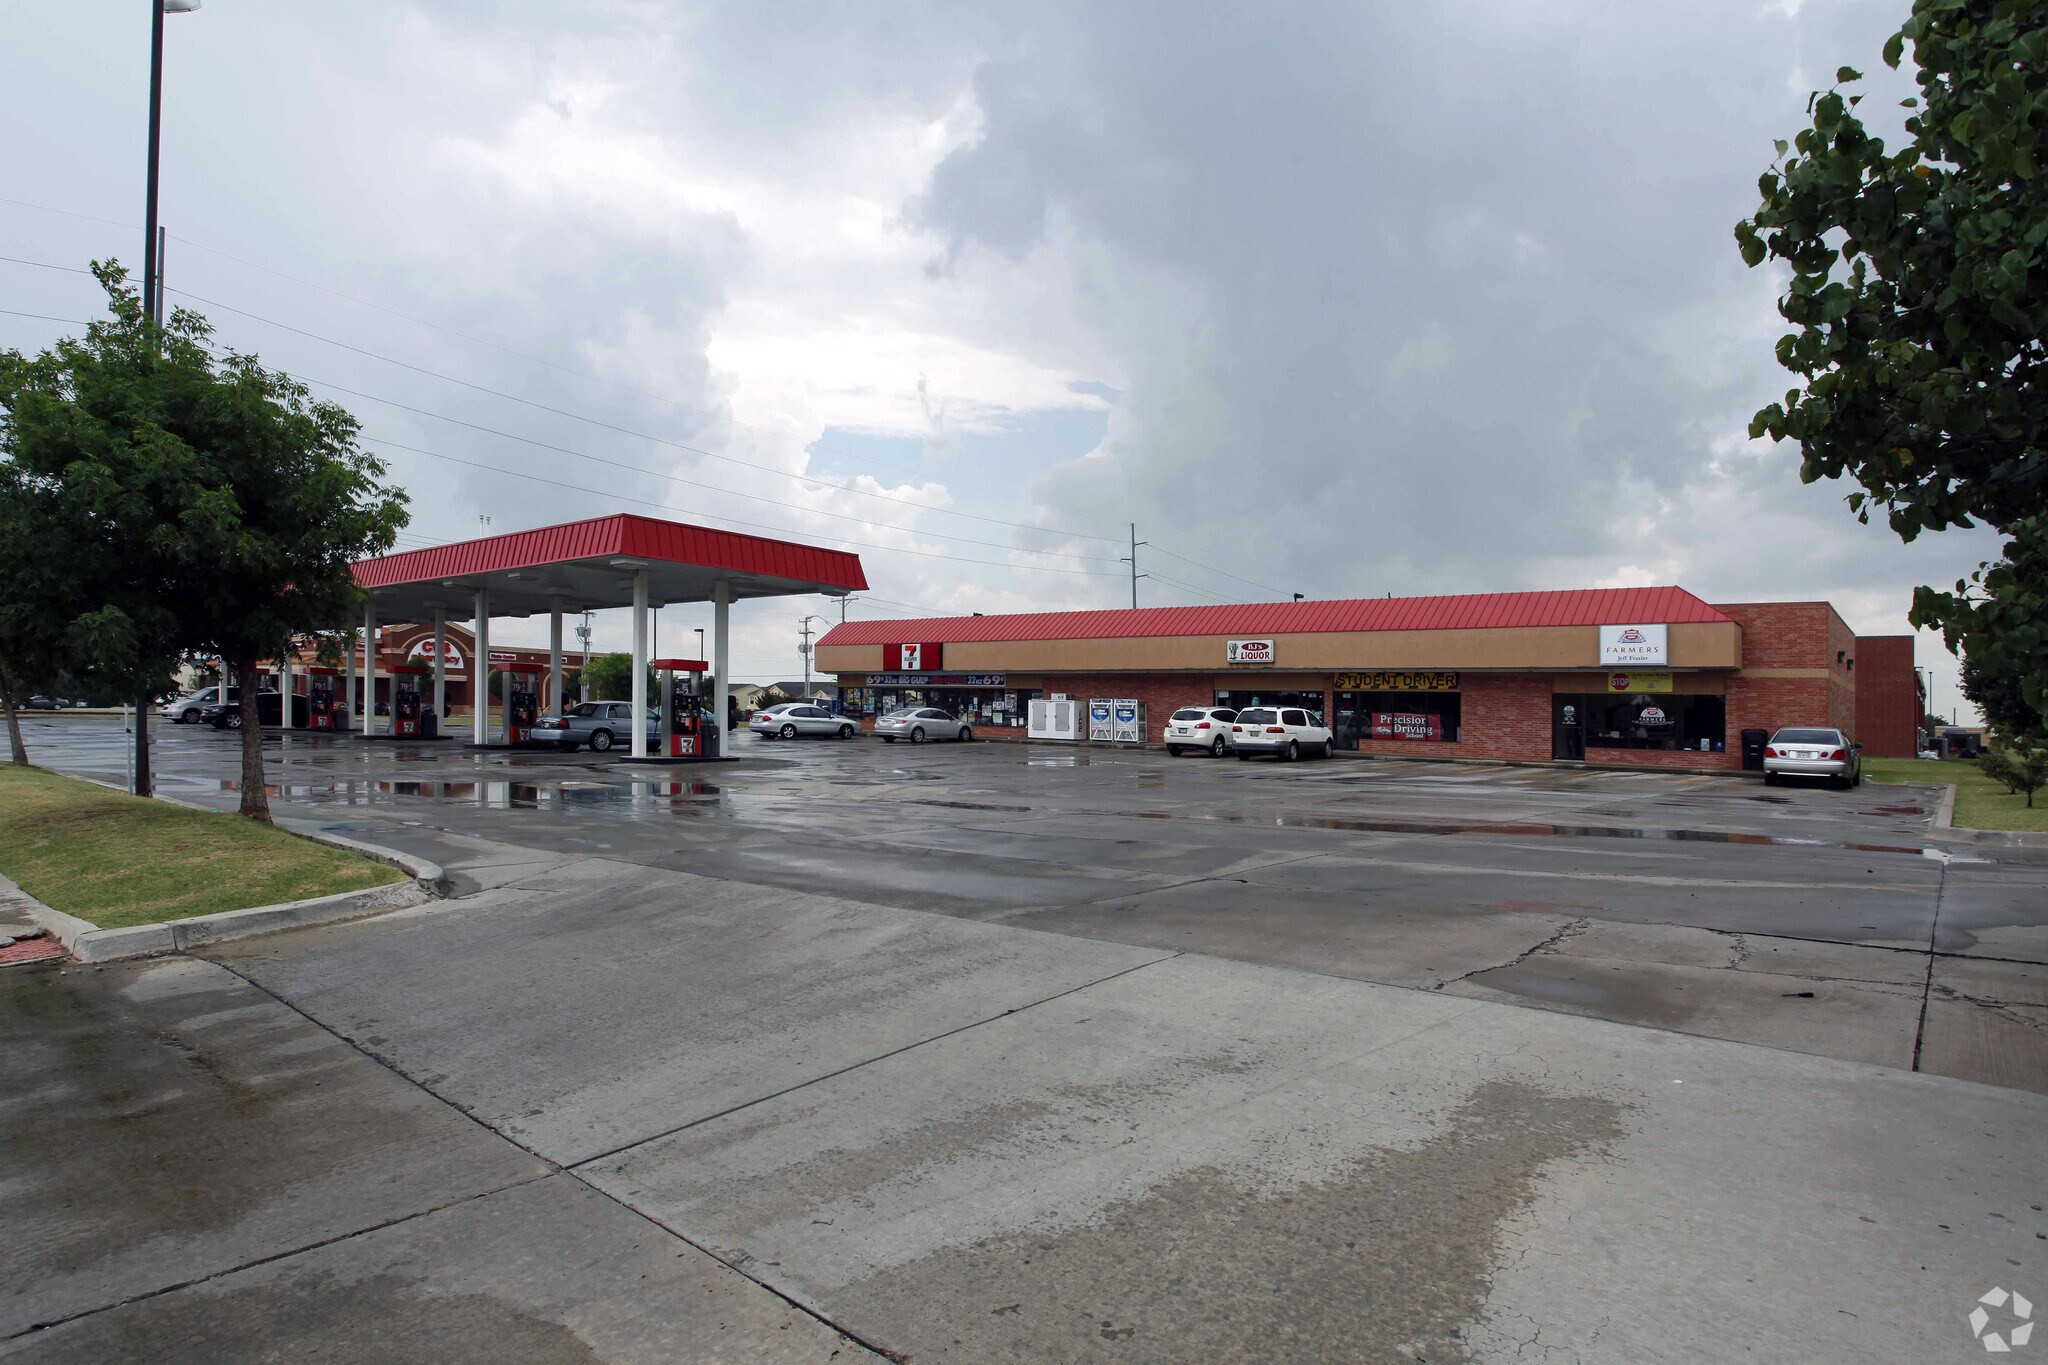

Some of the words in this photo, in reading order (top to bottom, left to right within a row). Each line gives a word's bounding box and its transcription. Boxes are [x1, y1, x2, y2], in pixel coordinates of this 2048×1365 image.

[905, 645, 917, 668] 7
[911, 675, 928, 684] GULP
[967, 675, 982, 684] 32oz
[1338, 674, 1399, 686] STUDENT
[1403, 674, 1455, 686] DRIVER
[1611, 678, 1629, 686] STOP
[1394, 724, 1432, 735] Driving
